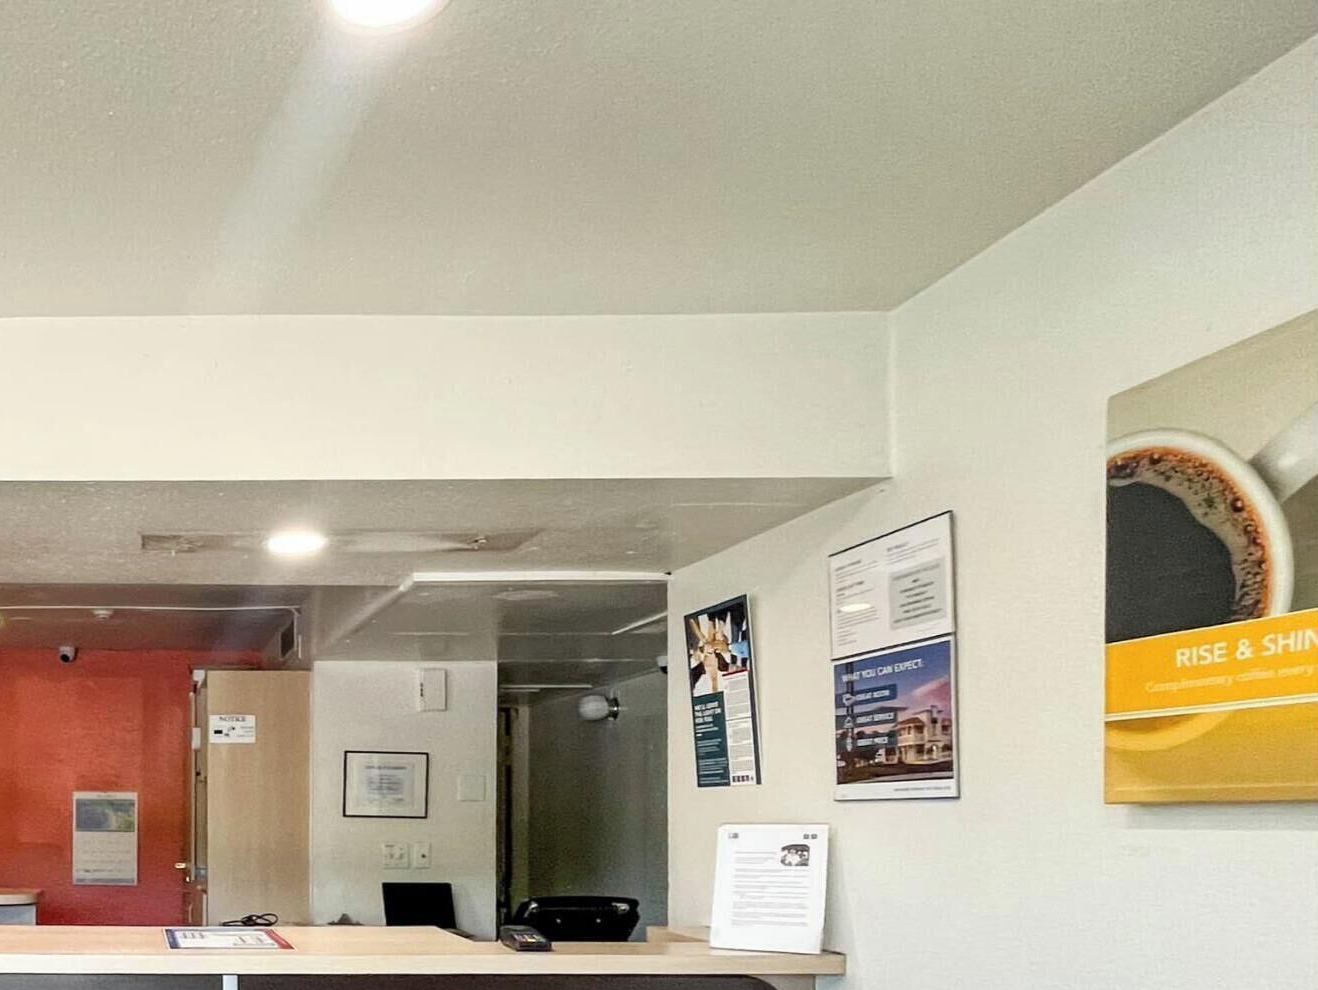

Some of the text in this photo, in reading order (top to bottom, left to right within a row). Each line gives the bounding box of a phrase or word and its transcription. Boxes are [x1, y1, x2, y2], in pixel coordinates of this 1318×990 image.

[1176, 642, 1227, 668] RISE
[1235, 638, 1254, 660] &
[842, 671, 860, 682] WHAT
[862, 669, 876, 678] YOU
[877, 666, 893, 675] CAN
